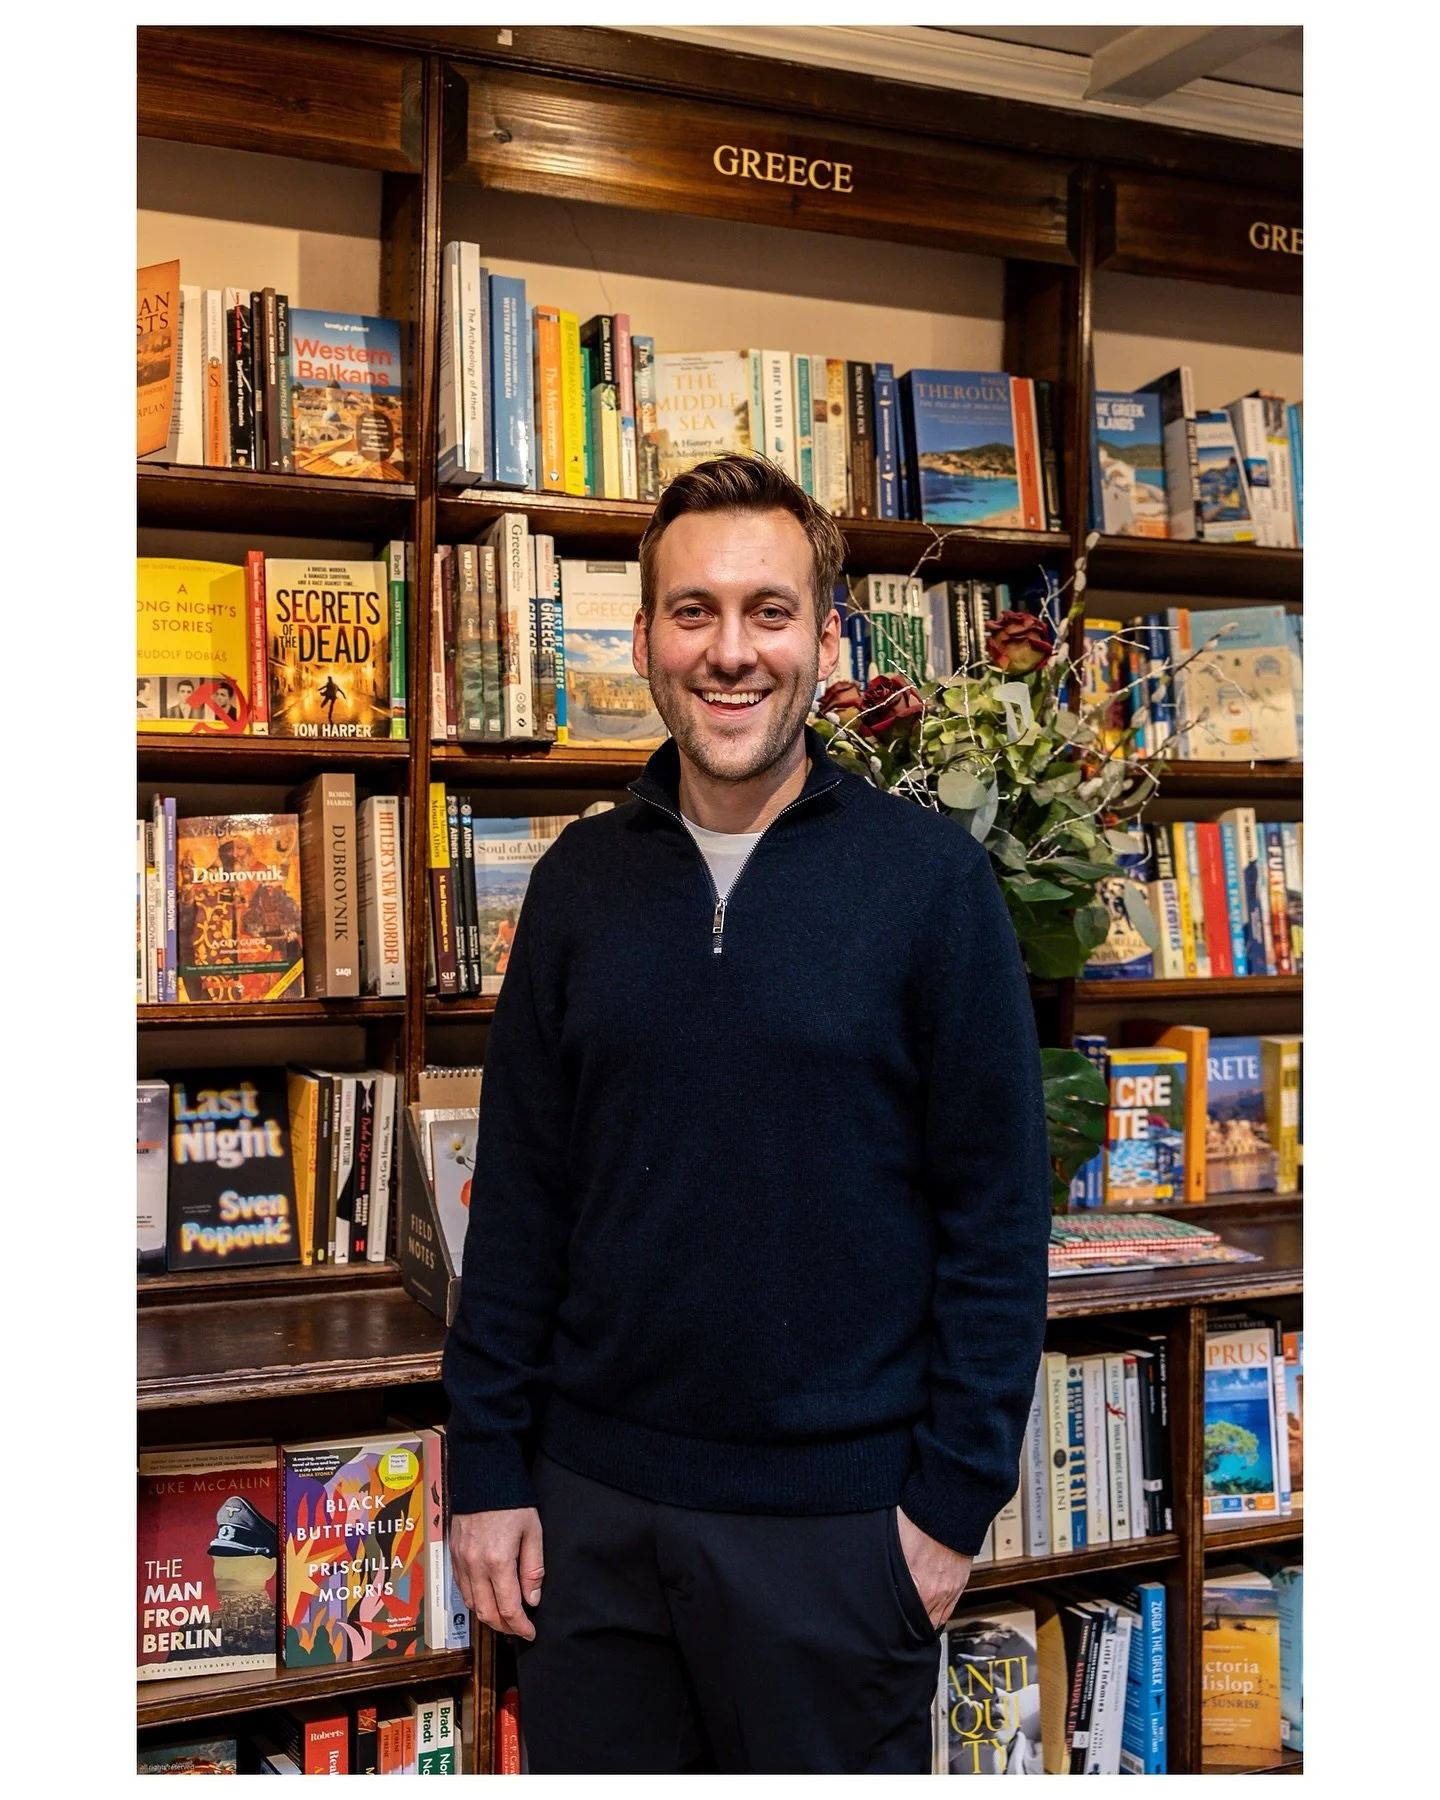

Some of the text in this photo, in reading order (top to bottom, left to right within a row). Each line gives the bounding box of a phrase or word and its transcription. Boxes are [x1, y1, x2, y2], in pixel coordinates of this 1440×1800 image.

[713, 144, 854, 193] GREECE
[1248, 221, 1303, 256] GRE
[278, 302, 287, 352] Peter Cameron
[293, 336, 392, 366] Western
[468, 308, 478, 421] The Archaeology of Athens
[604, 342, 612, 381] TRAVELER
[298, 360, 390, 388] Balkans
[504, 334, 512, 399] MEDITERRANEAN
[855, 366, 863, 393] ROBIN
[280, 379, 288, 408] HAPPENS
[638, 344, 652, 434] The Warm South
[673, 373, 717, 390] THE
[772, 360, 784, 428] ERIC NEWBY
[916, 383, 1008, 402] THEROUX
[546, 366, 558, 460] The Mediterranean
[656, 392, 740, 412] MIDDLE
[679, 414, 716, 432] SEA
[673, 437, 724, 448] A History of
[512, 524, 523, 568] Greece
[177, 583, 188, 595] A
[137, 600, 237, 618] ONG NIGHT'S
[276, 588, 381, 625] SECRETS
[554, 606, 562, 631] BEST
[576, 601, 638, 617] GREECE
[152, 619, 213, 634] STORIES
[282, 624, 294, 636] OF
[540, 602, 555, 656] GREECE
[137, 647, 228, 663] RUDOLF DOBIÁS
[279, 635, 298, 650] THE
[298, 624, 371, 664] DEAD
[556, 652, 564, 689] GREECE
[293, 722, 372, 738] TOM HARPER
[378, 812, 396, 868] HITLER'S
[450, 826, 458, 858] Athens
[464, 826, 472, 858] Athens
[478, 842, 547, 854] Soul of Ath
[191, 864, 284, 884] Dubrovnik
[1158, 857, 1174, 879] THE
[1224, 826, 1242, 934] MICHAEL FRAYN
[332, 825, 348, 942] DUBROVNIK
[382, 870, 398, 897] NEW
[1162, 882, 1181, 952] DESTROYERS
[211, 938, 266, 948] A CITY GUIDE
[382, 902, 400, 965] DISORDER
[336, 968, 352, 976] SAQI
[1208, 1055, 1259, 1082] RETE
[173, 1080, 259, 1120] Last
[1115, 1075, 1172, 1108] CRE
[1114, 1108, 1150, 1141] TE
[173, 1118, 285, 1169] Night
[381, 1133, 389, 1158] Home,
[381, 1160, 388, 1172] Go
[379, 1174, 387, 1192] Let's
[218, 1190, 289, 1222] Sven
[181, 1215, 292, 1257] Popović
[411, 1214, 432, 1242] FIELD
[408, 1236, 435, 1270] NOTES
[1208, 1342, 1268, 1366] PRUS
[1052, 1378, 1064, 1444] NICHOLAS GAGE
[1074, 1386, 1084, 1440] NICHOLAS
[1032, 1427, 1041, 1470] Struggle
[193, 1476, 270, 1492] McCALLIN
[384, 1474, 414, 1482] Shortlisted
[1069, 1444, 1088, 1512] ELENI
[326, 1494, 386, 1514] BLACK
[1057, 1474, 1066, 1512] ELENI
[296, 1517, 416, 1542] BUTTERFLIES
[145, 1558, 183, 1580] THE
[309, 1556, 404, 1577] PRISCILLA
[144, 1581, 202, 1604] MAN
[318, 1582, 394, 1603] MORRIS
[144, 1604, 211, 1629] FROM
[143, 1628, 222, 1654] BERLIN
[1151, 1600, 1163, 1686] ZORBA THE GREEK
[188, 1662, 235, 1670] REINHARDT
[948, 1655, 1028, 1698] ANTI
[1098, 1638, 1113, 1713] Little Infamies
[1206, 1658, 1260, 1674] ctoria
[951, 1694, 1022, 1740] QUI
[1212, 1700, 1260, 1710] SUNRISE
[310, 1729, 344, 1742] Roberts
[423, 1711, 434, 1744] Bradt
[440, 1706, 450, 1738] Bradt
[510, 1735, 518, 1744] C.
[510, 1746, 517, 1754] P.
[328, 1750, 340, 1774] Real
[423, 1758, 433, 1774] No
[440, 1753, 450, 1774] Nor
[962, 1738, 1008, 1774] TY
